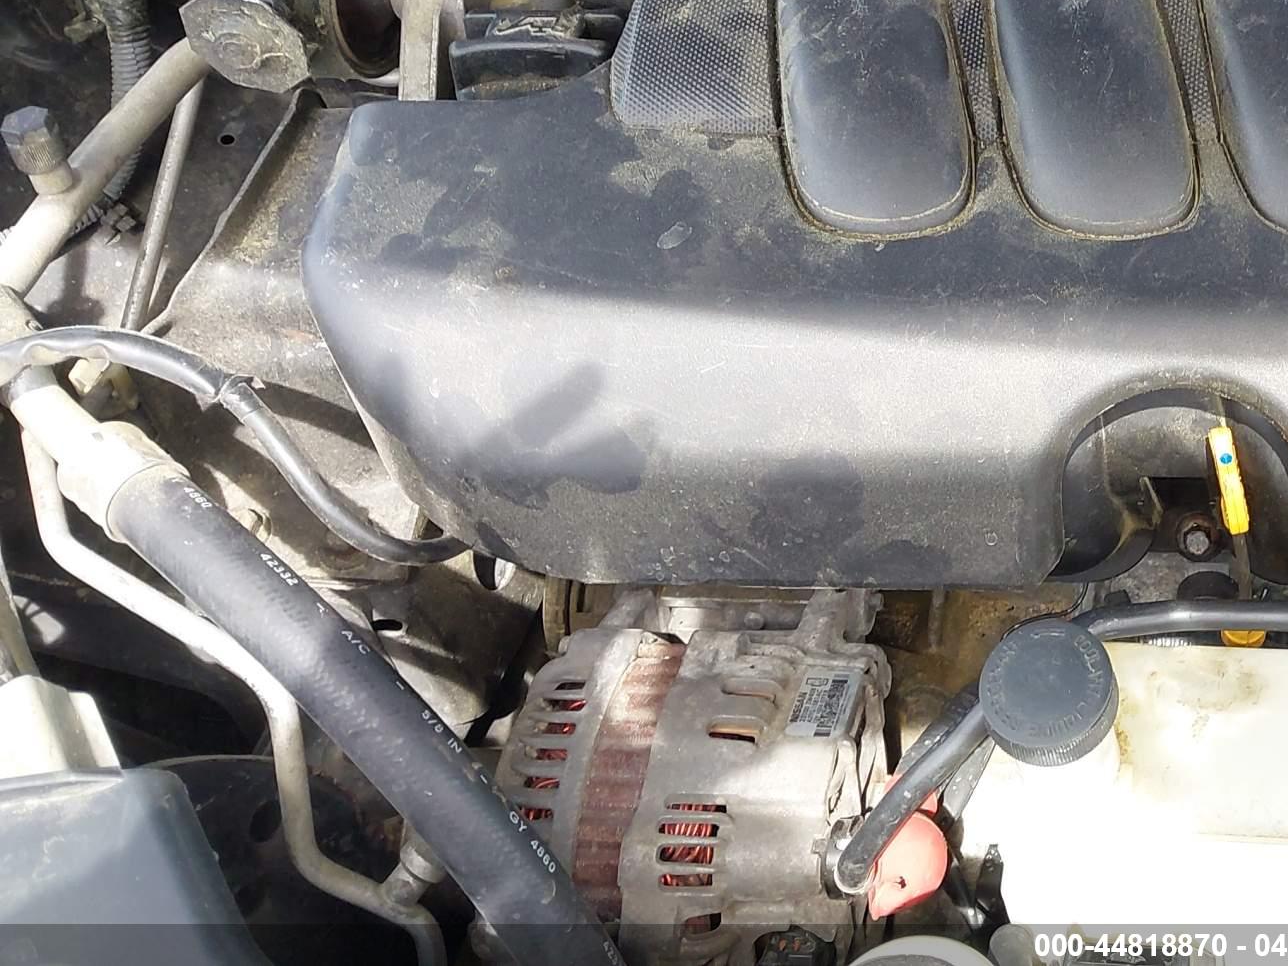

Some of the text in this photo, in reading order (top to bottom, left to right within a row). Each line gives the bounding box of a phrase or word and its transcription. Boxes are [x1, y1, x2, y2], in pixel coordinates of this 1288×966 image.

[183, 486, 213, 508] 4860
[260, 552, 299, 587] 42332
[340, 629, 371, 655] A/C
[447, 737, 463, 754] IN
[508, 810, 528, 832] GY
[530, 839, 557, 873] 4860
